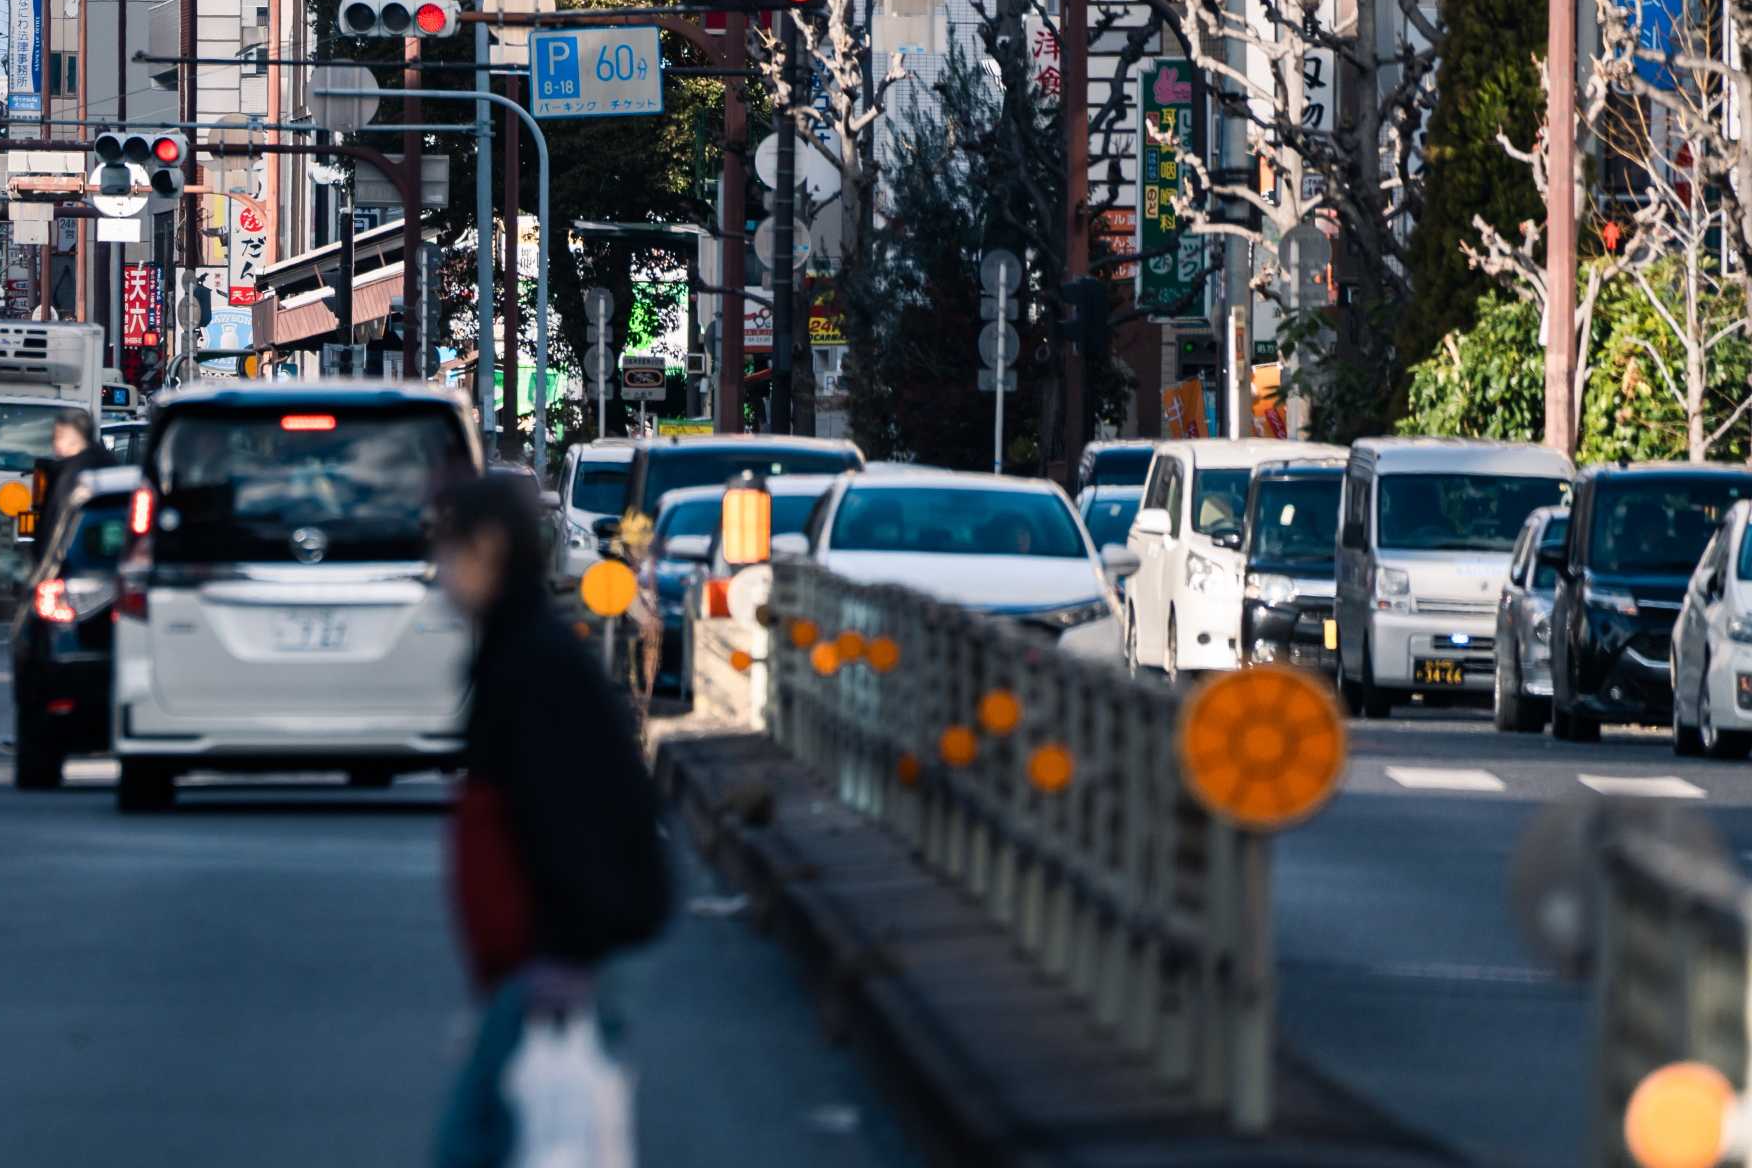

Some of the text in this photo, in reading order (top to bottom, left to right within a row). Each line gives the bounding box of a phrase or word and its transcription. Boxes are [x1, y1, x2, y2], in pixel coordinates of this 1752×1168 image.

[548, 41, 569, 76] P
[595, 43, 648, 82] 60分
[544, 79, 574, 95] 8-18
[130, 270, 147, 333] 天六
